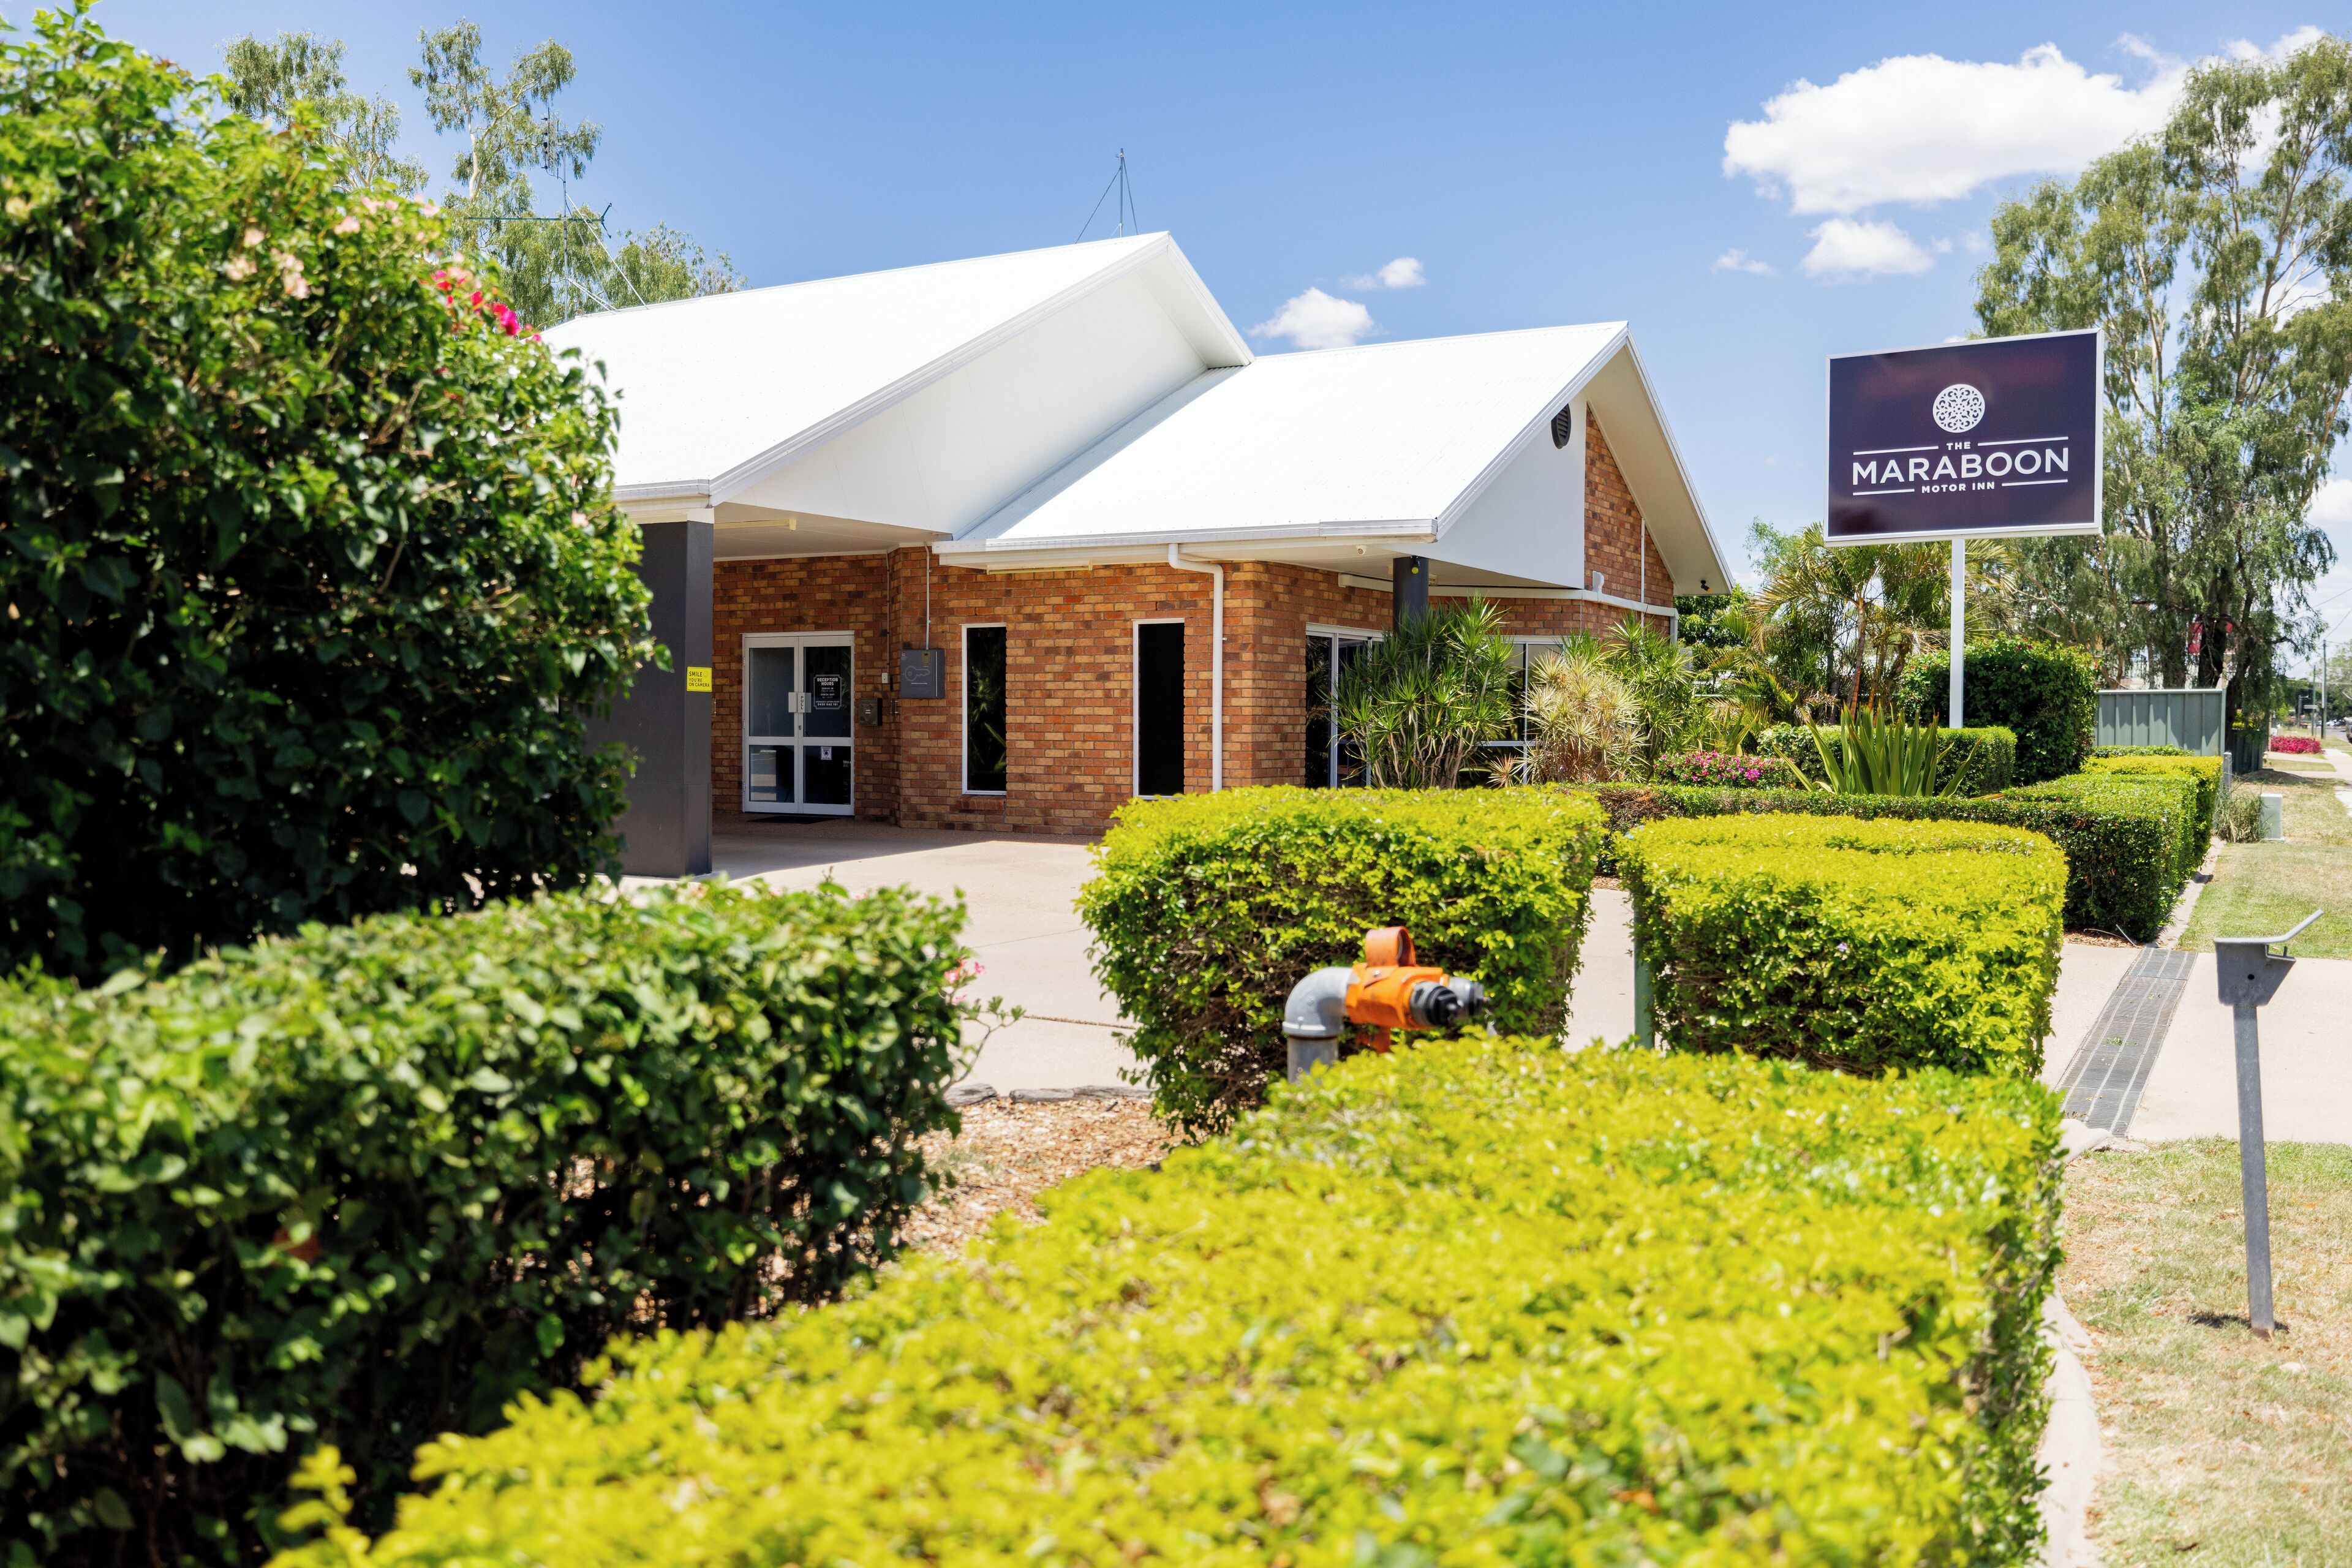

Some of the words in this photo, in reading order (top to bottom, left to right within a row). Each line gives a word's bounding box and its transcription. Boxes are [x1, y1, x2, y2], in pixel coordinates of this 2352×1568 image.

[1947, 442, 1971, 450] THE
[1853, 448, 2068, 485] MARABOON
[1921, 483, 1966, 493] MOTOR
[1972, 481, 1995, 491] INN
